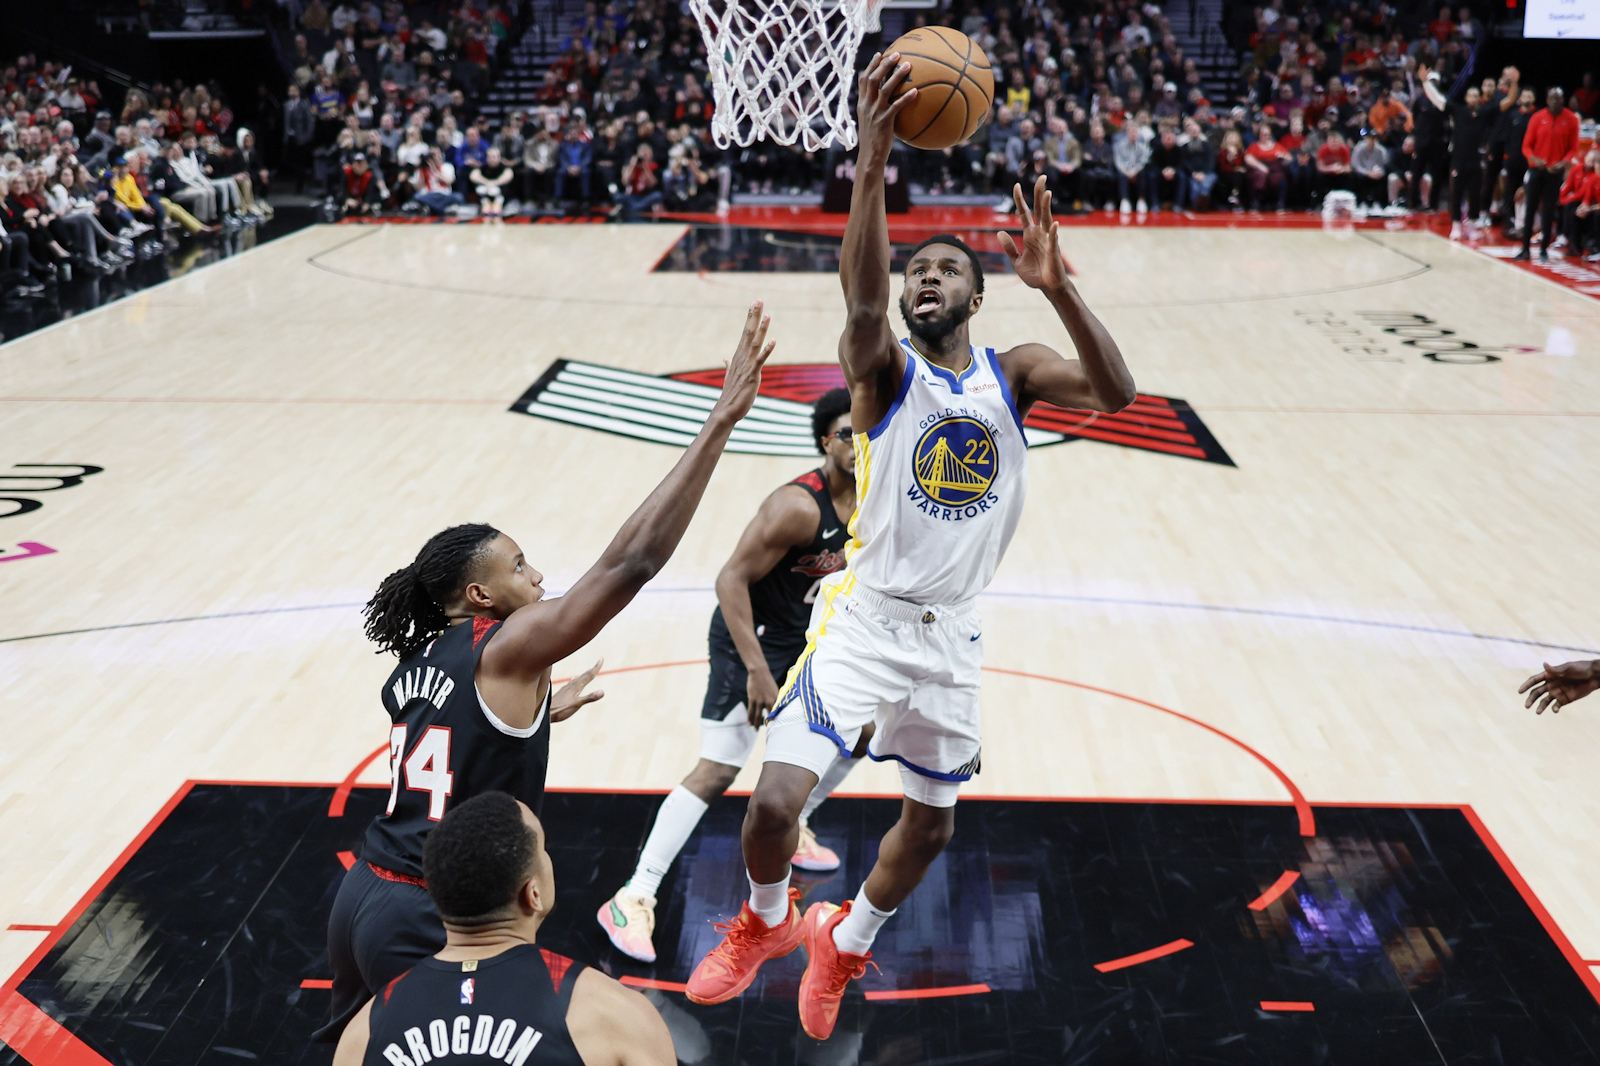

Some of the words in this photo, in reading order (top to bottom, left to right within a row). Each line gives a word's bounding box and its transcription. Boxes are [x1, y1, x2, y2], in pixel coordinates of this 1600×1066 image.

[972, 409, 1000, 438] STATE
[963, 438, 991, 465] 22
[906, 483, 999, 521] WARRIORS
[392, 665, 456, 710] WALKER
[382, 1014, 543, 1066] BROGDON
